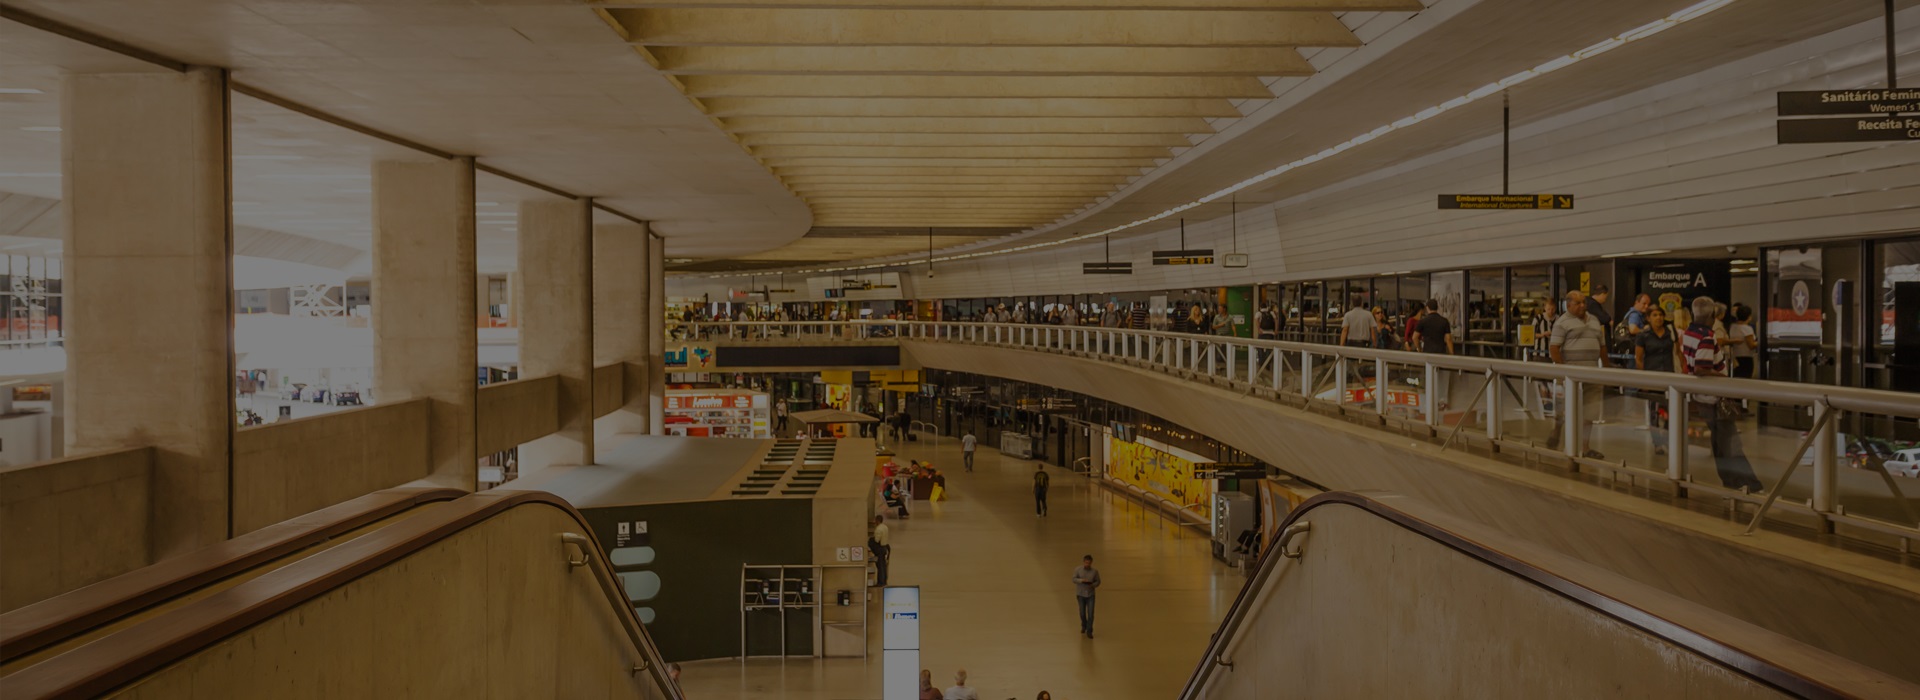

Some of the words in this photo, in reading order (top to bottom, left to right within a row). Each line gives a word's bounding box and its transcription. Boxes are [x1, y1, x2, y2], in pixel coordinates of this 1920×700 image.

[1822, 91, 1879, 102] Sanitário
[1870, 103, 1915, 112] Women's
[1858, 119, 1902, 130] Receita
[1649, 271, 1690, 281] Embarque
[1694, 272, 1707, 287] A
